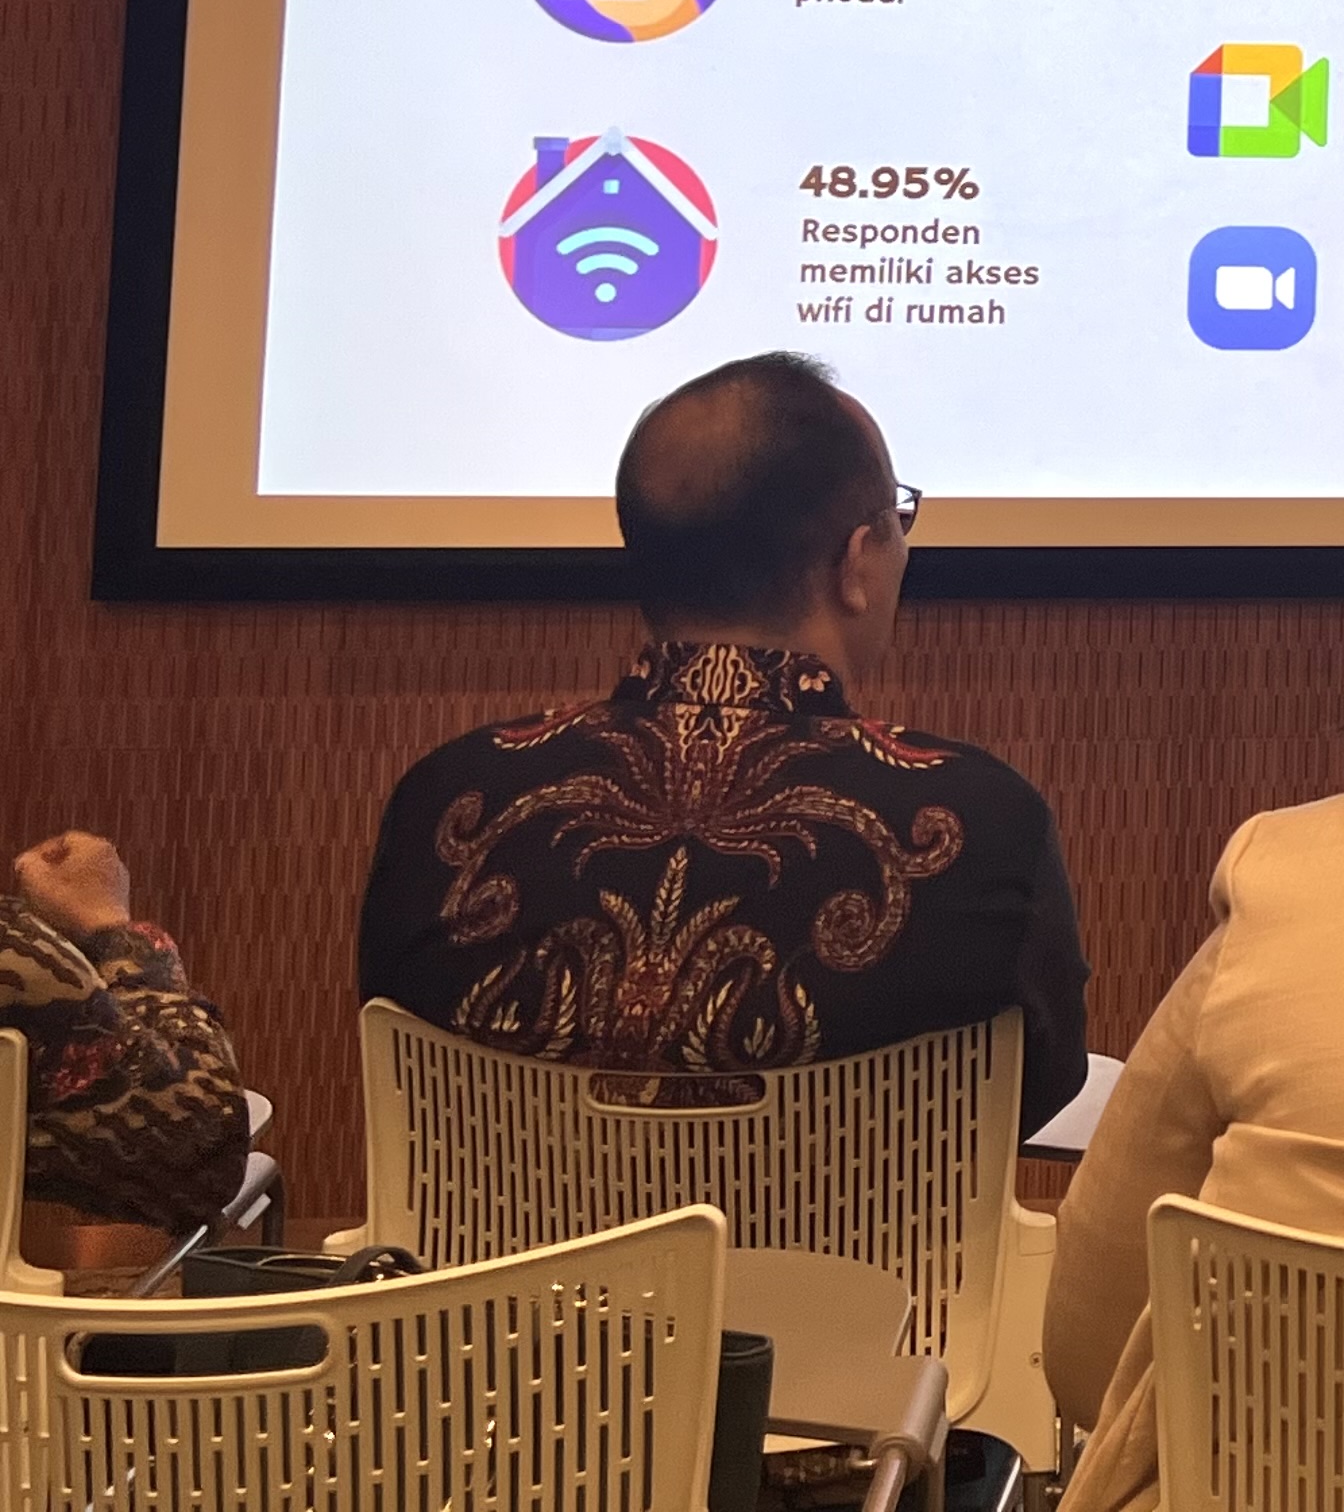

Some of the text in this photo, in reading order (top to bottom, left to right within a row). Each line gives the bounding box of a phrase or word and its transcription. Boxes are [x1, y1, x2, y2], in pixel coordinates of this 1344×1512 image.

[800, 166, 979, 200] 48.95%
[803, 218, 979, 249] Responden
[801, 257, 1038, 284] memiliki akses
[797, 296, 1004, 324] wifi di rumah
